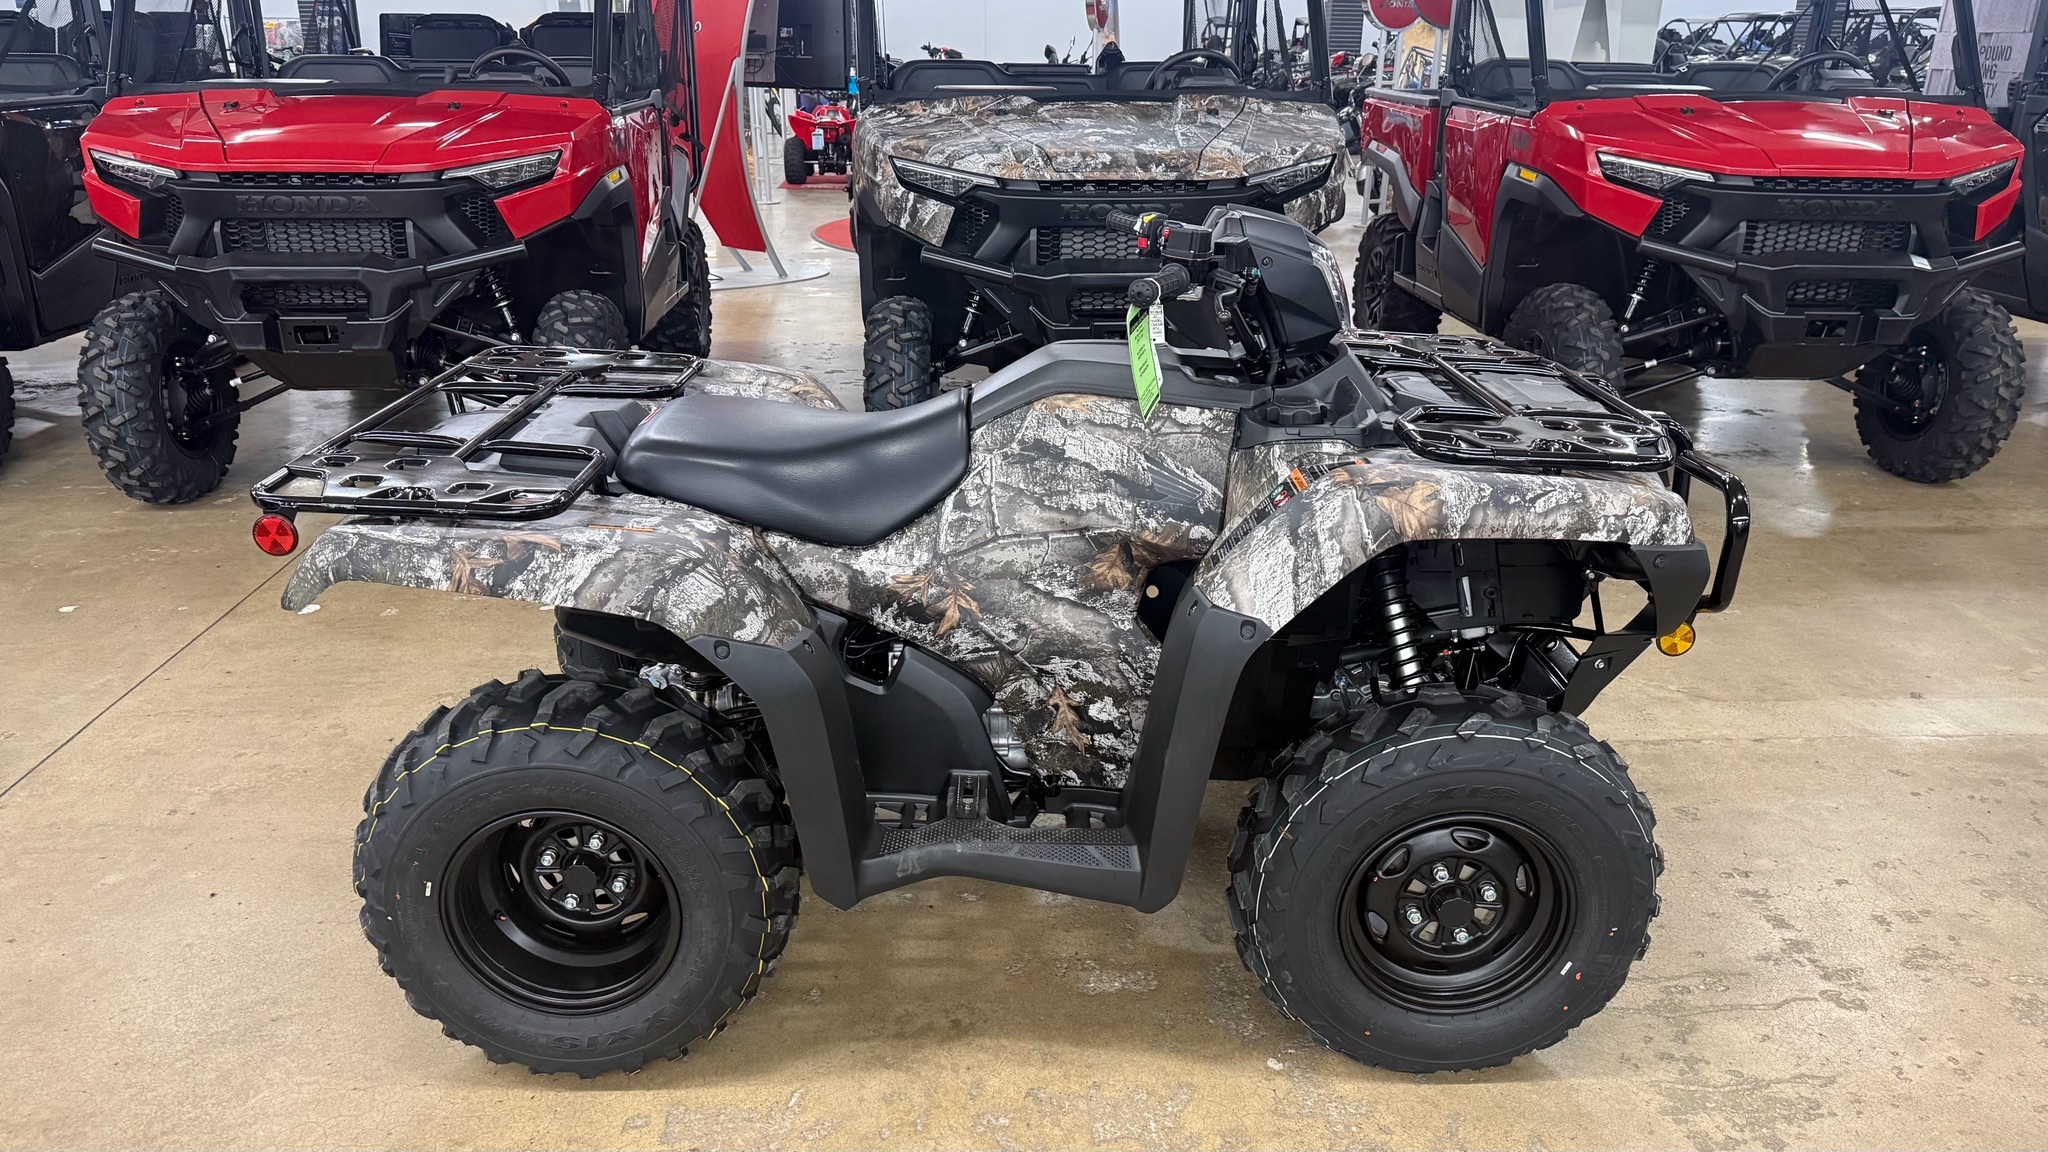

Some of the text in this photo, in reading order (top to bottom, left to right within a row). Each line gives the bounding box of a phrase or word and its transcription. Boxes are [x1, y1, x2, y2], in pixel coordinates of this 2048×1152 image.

[1980, 45, 2012, 61] POUND
[1984, 82, 1998, 98] TY
[235, 194, 382, 214] HONDA
[1775, 198, 1894, 216] HONDA
[1324, 784, 1521, 864] MAXXIS
[552, 956, 708, 1050] MAXXIS
